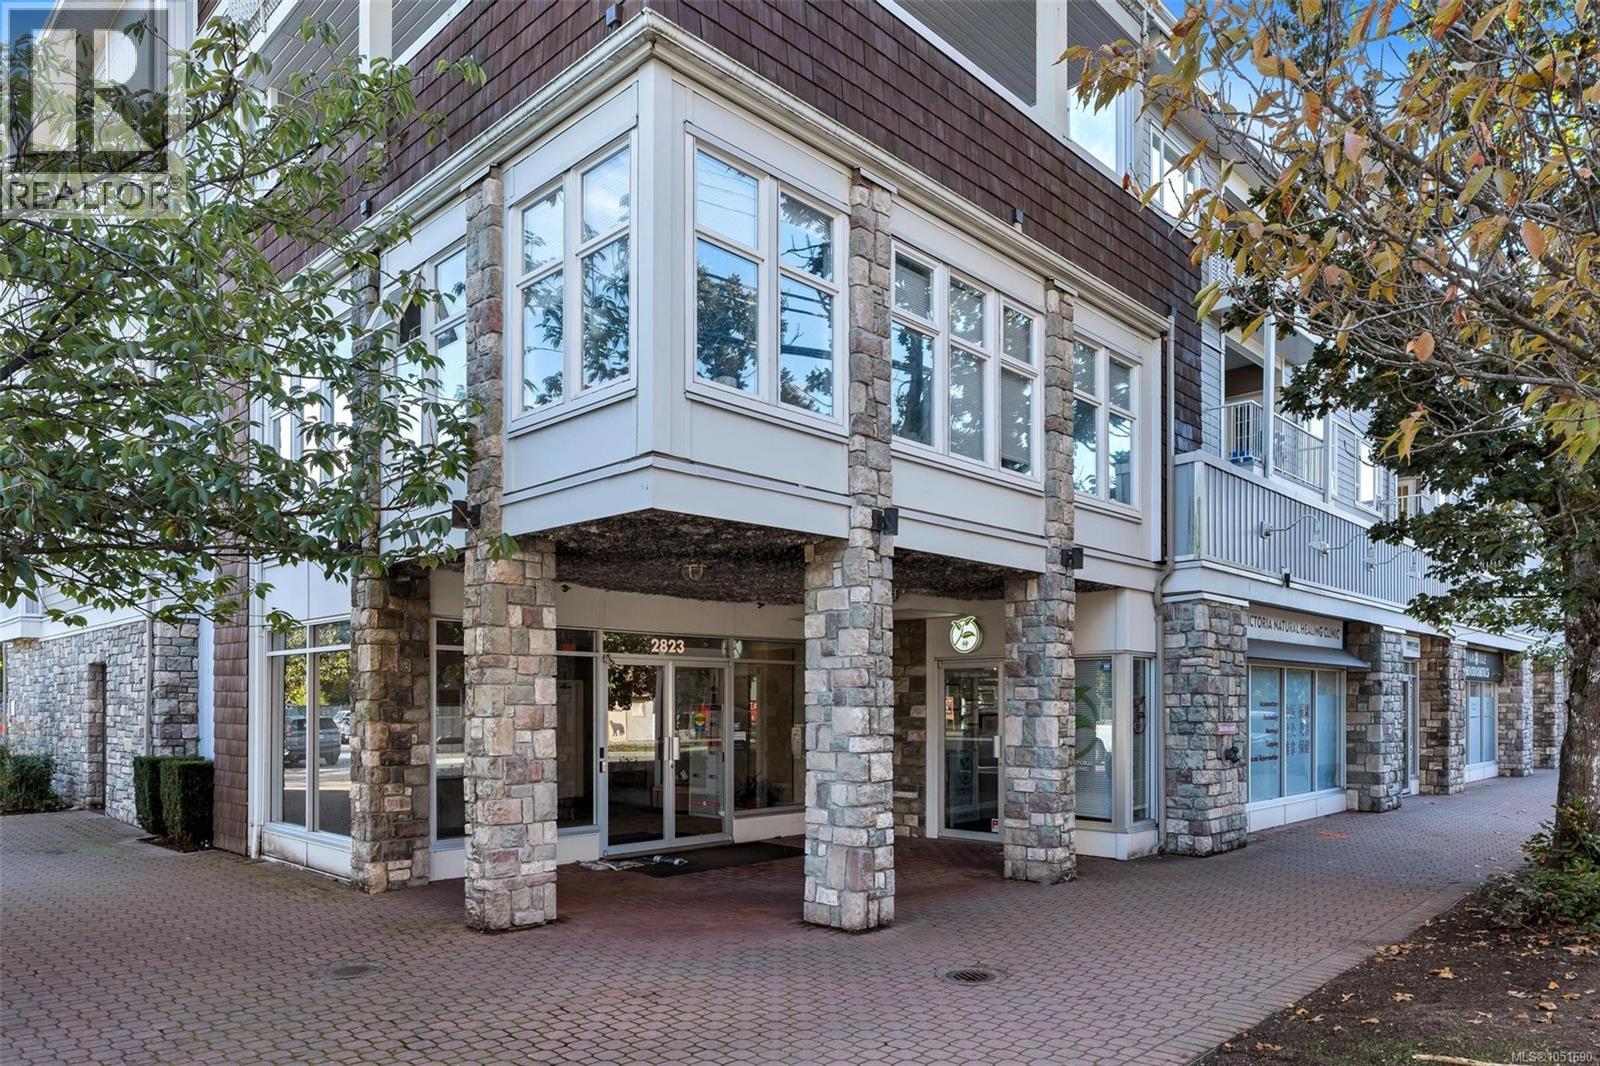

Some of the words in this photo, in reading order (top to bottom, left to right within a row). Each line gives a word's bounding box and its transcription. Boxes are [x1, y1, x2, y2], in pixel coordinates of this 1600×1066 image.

[1247, 615, 1273, 630] ICTORIA
[1273, 619, 1300, 634] NATURAL
[1300, 623, 1323, 637] HEALING
[1324, 627, 1340, 640] CLINIC
[651, 638, 685, 653] 2823
